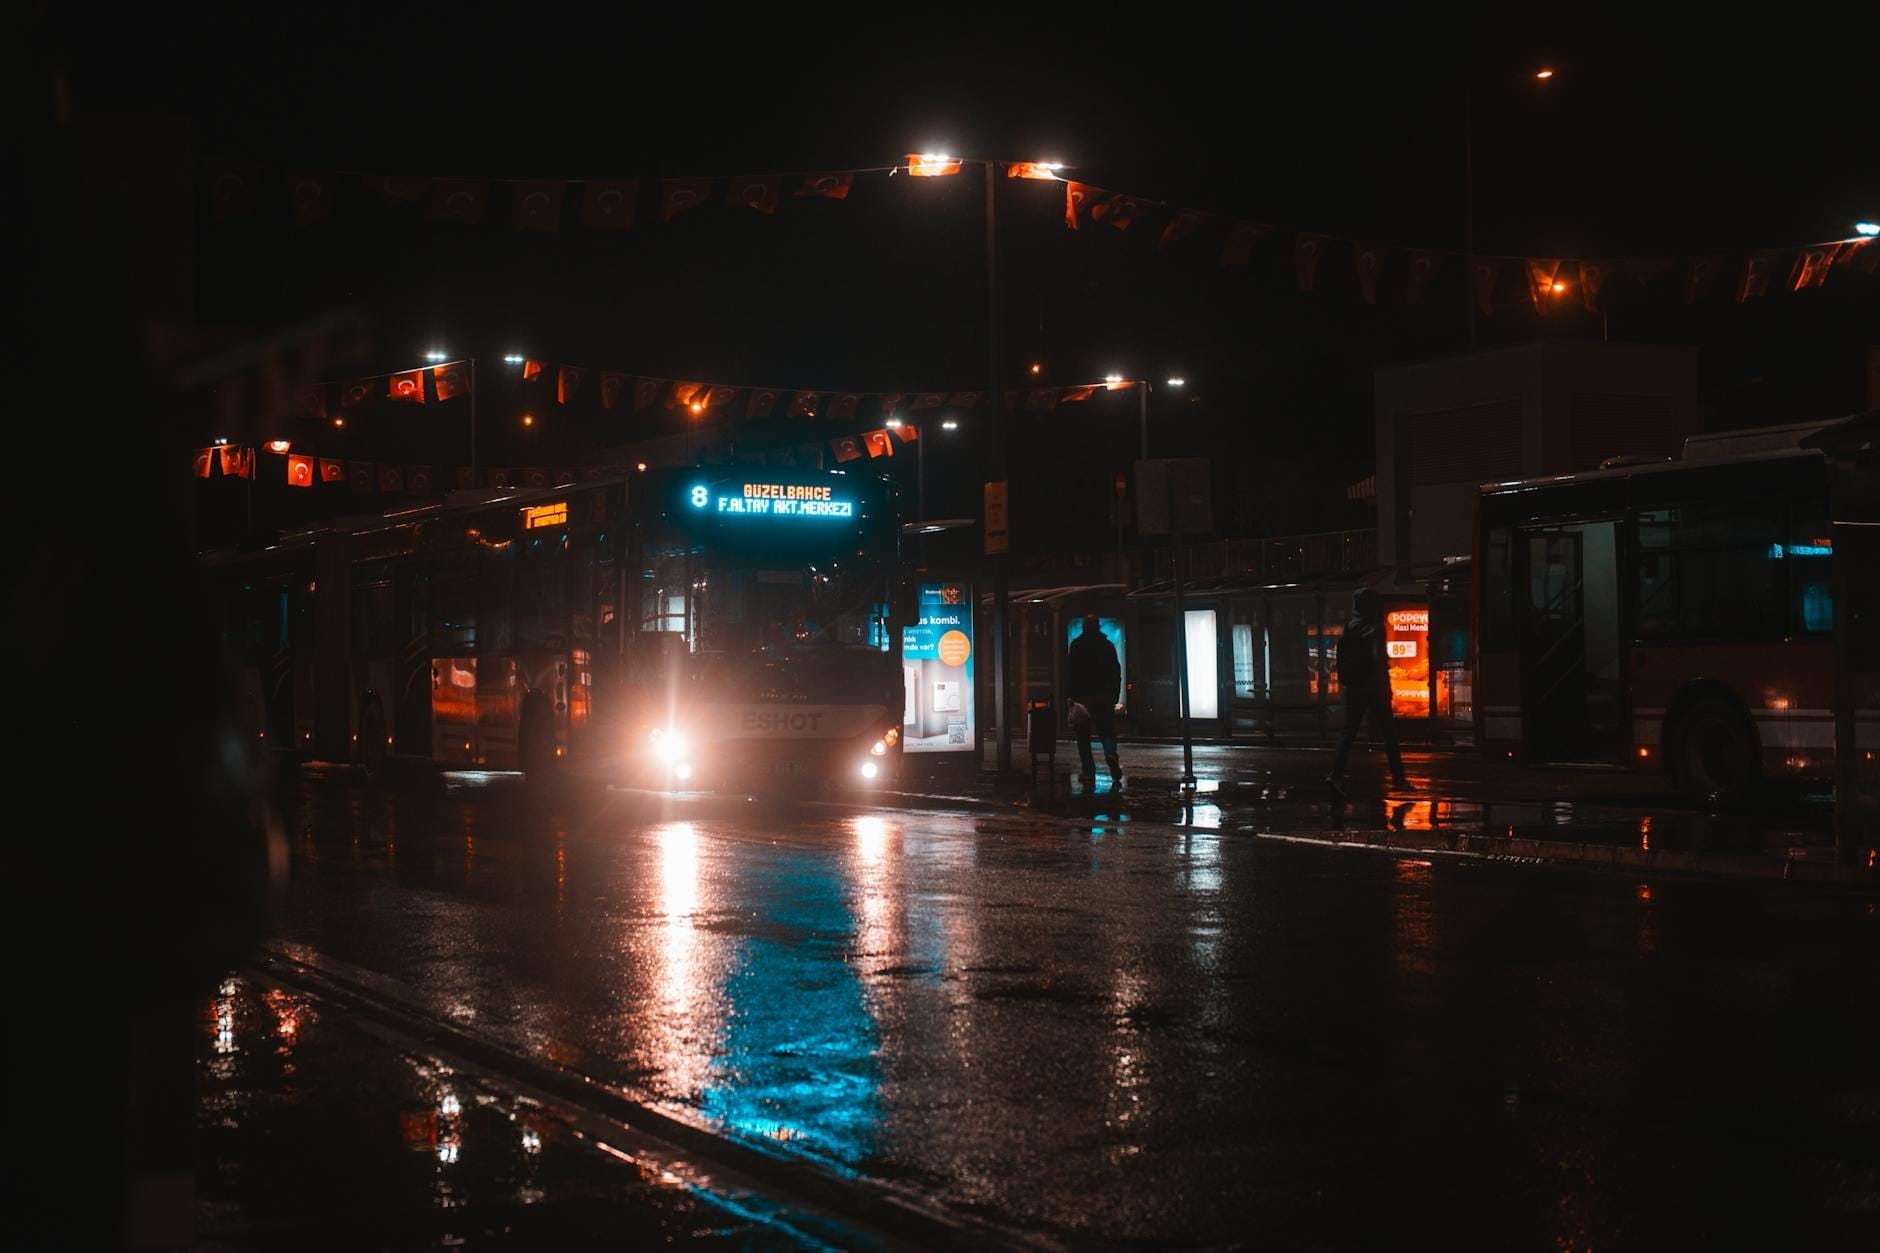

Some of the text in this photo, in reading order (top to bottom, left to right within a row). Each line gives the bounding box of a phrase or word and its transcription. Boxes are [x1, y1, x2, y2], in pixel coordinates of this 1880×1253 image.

[692, 485, 708, 508] 8
[719, 498, 770, 513] F.ALTAY
[929, 615, 961, 625] kombi.
[1392, 644, 1406, 655] 89
[743, 711, 824, 731] ESHOT
